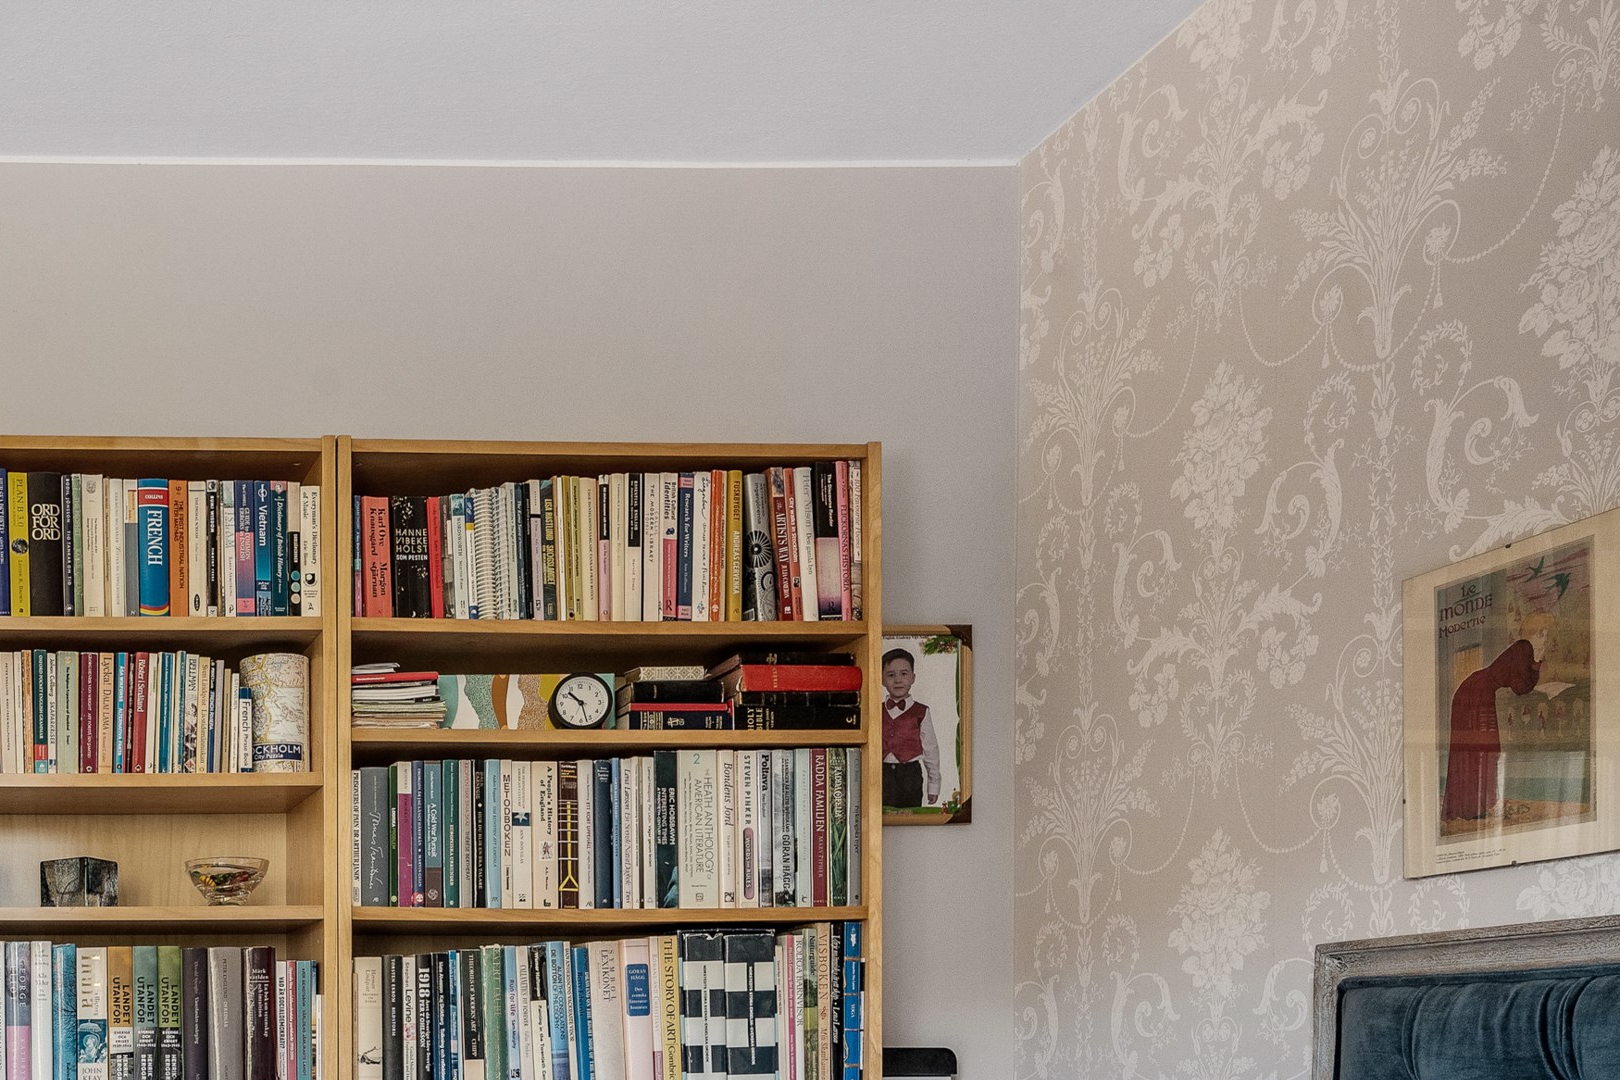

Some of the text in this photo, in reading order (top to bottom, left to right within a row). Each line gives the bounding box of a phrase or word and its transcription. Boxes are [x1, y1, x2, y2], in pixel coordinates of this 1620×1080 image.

[31, 503, 60, 516] ORD
[32, 514, 60, 528] FÖR
[259, 505, 268, 546] Vietnam
[378, 509, 386, 547] Karl Ove
[683, 493, 691, 558] Research for Writers
[32, 528, 61, 540] ORD
[147, 510, 163, 566] FRENCH
[395, 529, 427, 537] HANNE
[395, 537, 427, 545] VIBEKE
[395, 545, 427, 553] HOLST
[379, 562, 388, 596] Morgon
[842, 554, 850, 592] HISTORIA
[1461, 584, 1477, 598] Le
[48, 675, 56, 697] Cullberg
[102, 657, 112, 730] Lycka! DALAI LAMA
[693, 754, 700, 765] 2
[761, 754, 769, 791] Poltava
[723, 763, 734, 827] Bondens Jord
[815, 755, 826, 832] RÄDDA FAMILJEN
[503, 774, 511, 857] METODBOKEN
[694, 779, 703, 873] AMERICAN LITERATURE
[703, 777, 714, 875] HEATH ANTHOLOGY
[782, 835, 791, 889] GÖRAN HÄGG
[551, 949, 557, 958] DE
[809, 935, 817, 976] Naturguide
[818, 934, 827, 1000] VISBOKEN
[279, 988, 286, 996] ÄR
[419, 967, 430, 998] 1918
[601, 949, 610, 1002] LEXIKONET
[663, 938, 676, 1043] THE STORY OF ART
[113, 977, 121, 1024] UTANFÖR
[122, 984, 130, 1024] LANDET
[137, 977, 145, 1024] UTANFÖR
[146, 984, 154, 1024] LANDET
[161, 977, 169, 1024] UTANFÖR
[405, 988, 413, 1023] Levine
